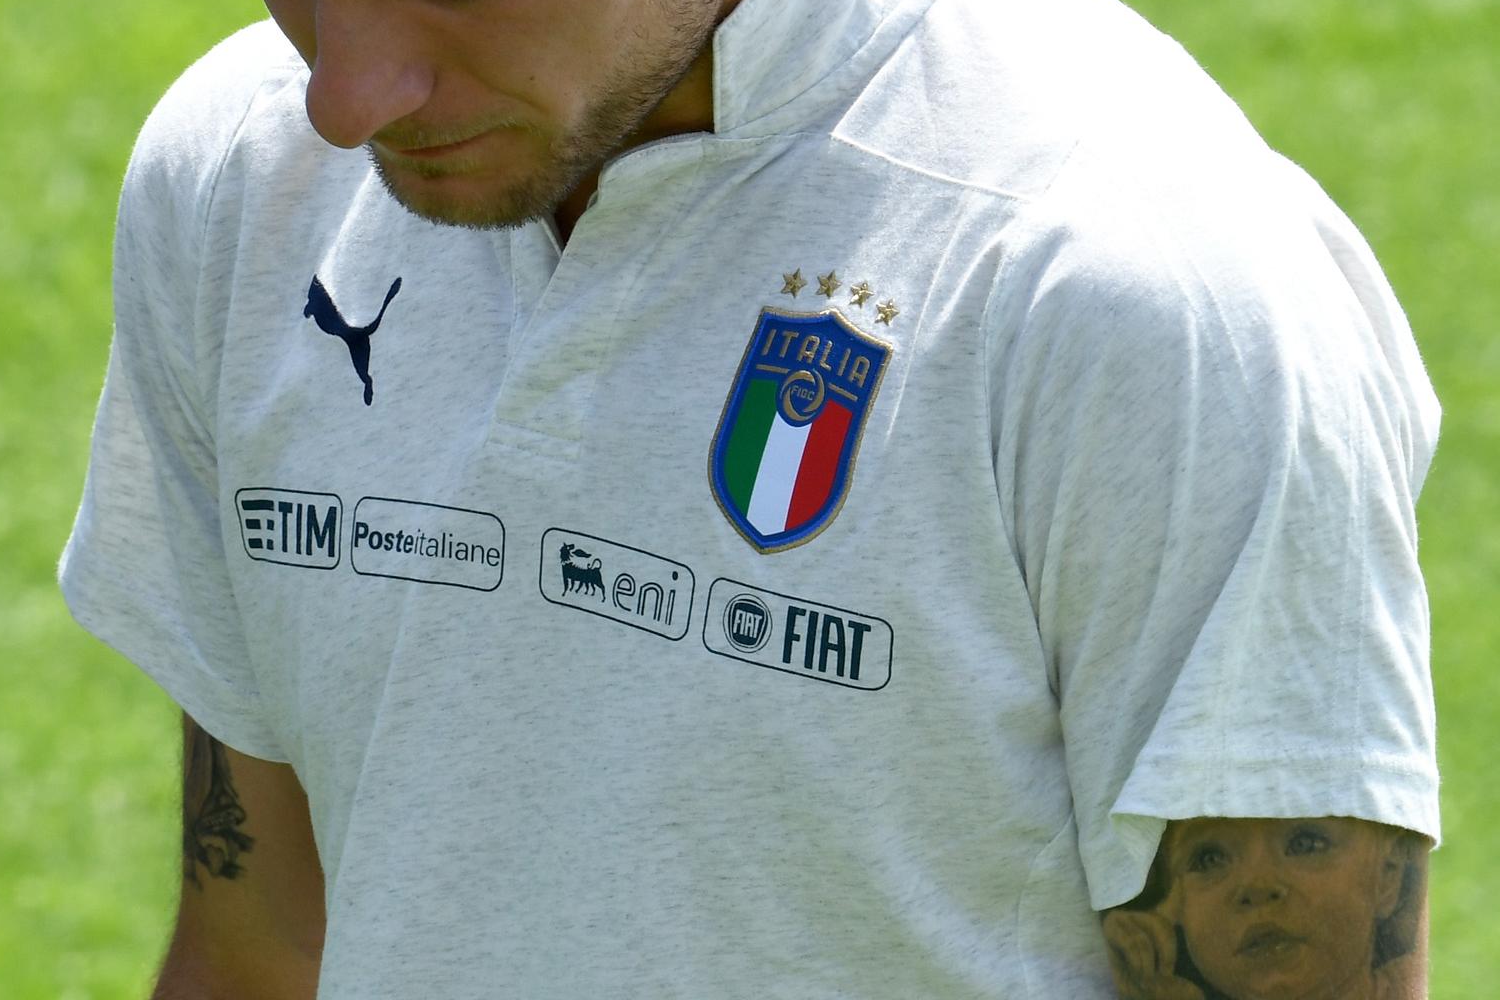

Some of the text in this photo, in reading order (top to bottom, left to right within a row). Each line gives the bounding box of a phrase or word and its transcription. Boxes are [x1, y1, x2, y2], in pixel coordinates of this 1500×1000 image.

[761, 328, 871, 388] ITALIA
[278, 501, 338, 558] TIM
[354, 521, 501, 567] Posteitaliane
[612, 570, 679, 626] eni
[733, 608, 763, 639] FIAT
[782, 605, 871, 681] FIAT
